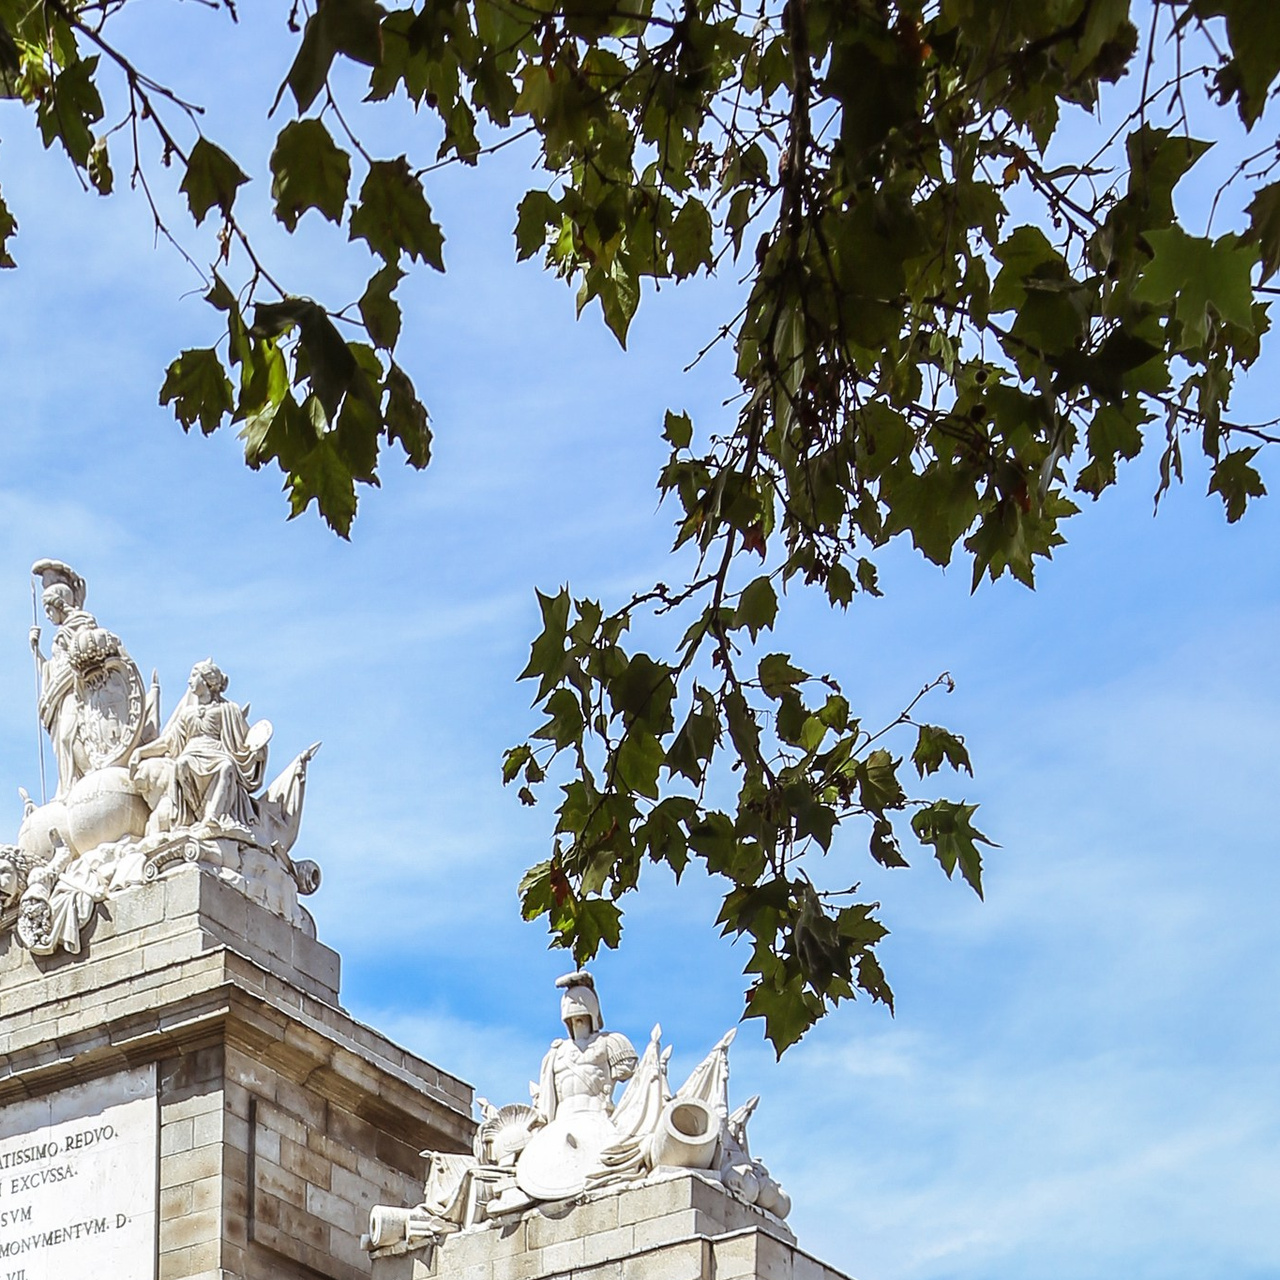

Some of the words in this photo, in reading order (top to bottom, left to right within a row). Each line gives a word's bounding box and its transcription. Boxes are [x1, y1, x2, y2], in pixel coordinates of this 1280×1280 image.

[64, 1124, 119, 1151] REDVO.
[10, 1164, 79, 1194] EXCVSSA.
[115, 1213, 132, 1229] D.
